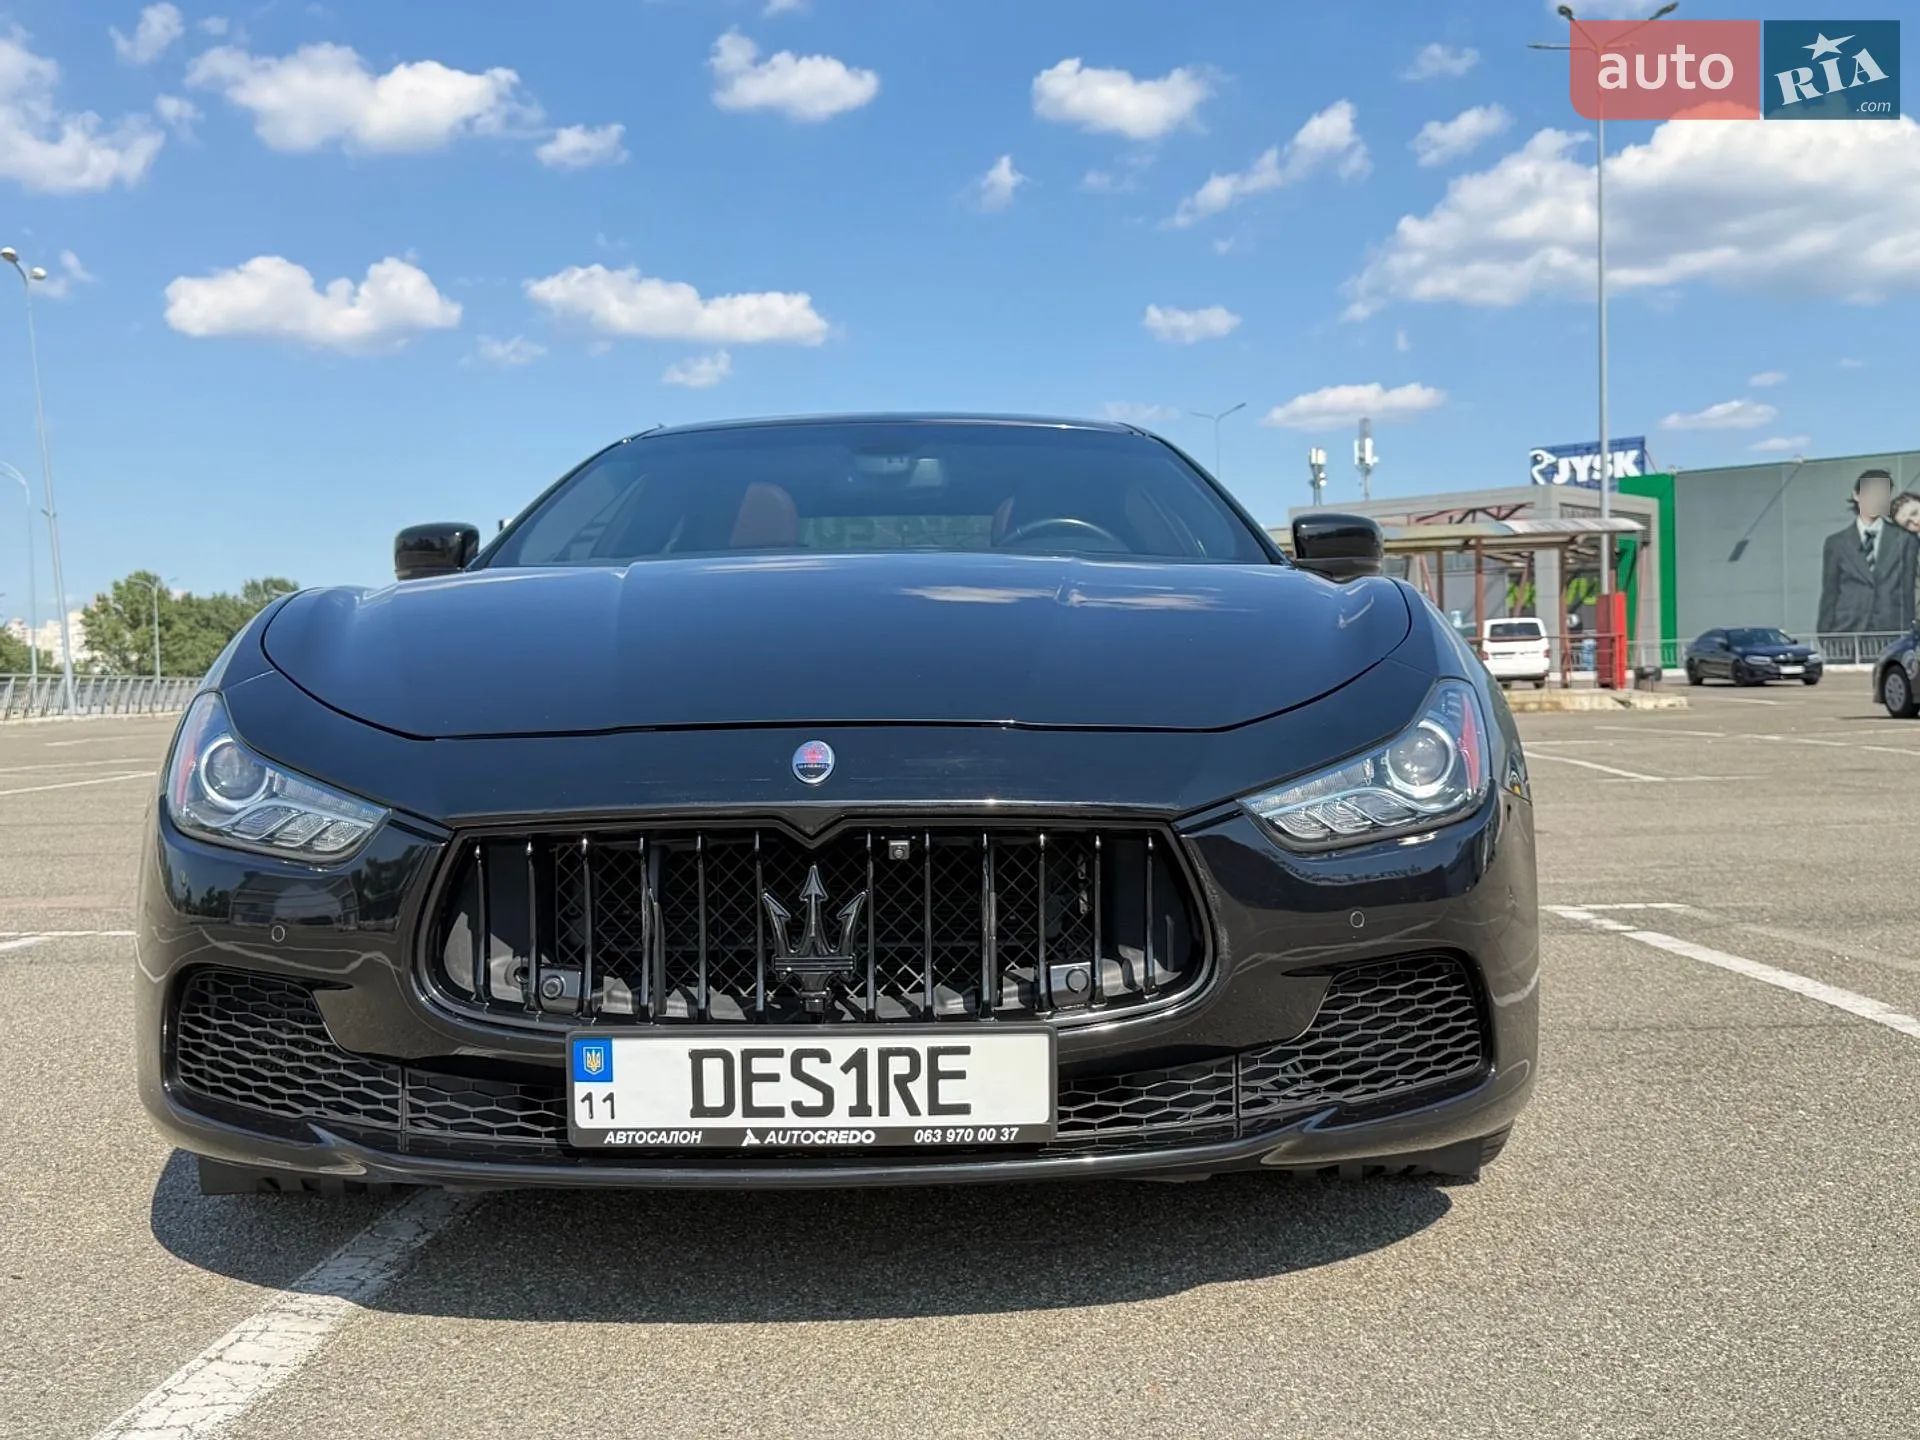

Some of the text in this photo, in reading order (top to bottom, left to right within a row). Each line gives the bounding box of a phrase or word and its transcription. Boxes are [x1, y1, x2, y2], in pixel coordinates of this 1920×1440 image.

[1552, 450, 1641, 485] JYSK
[688, 1046, 972, 1119] DES1RE
[580, 1091, 616, 1120] 11
[604, 1127, 1019, 1145] АВТОСАЛОН AUTOCREDO 063 970 00 37
